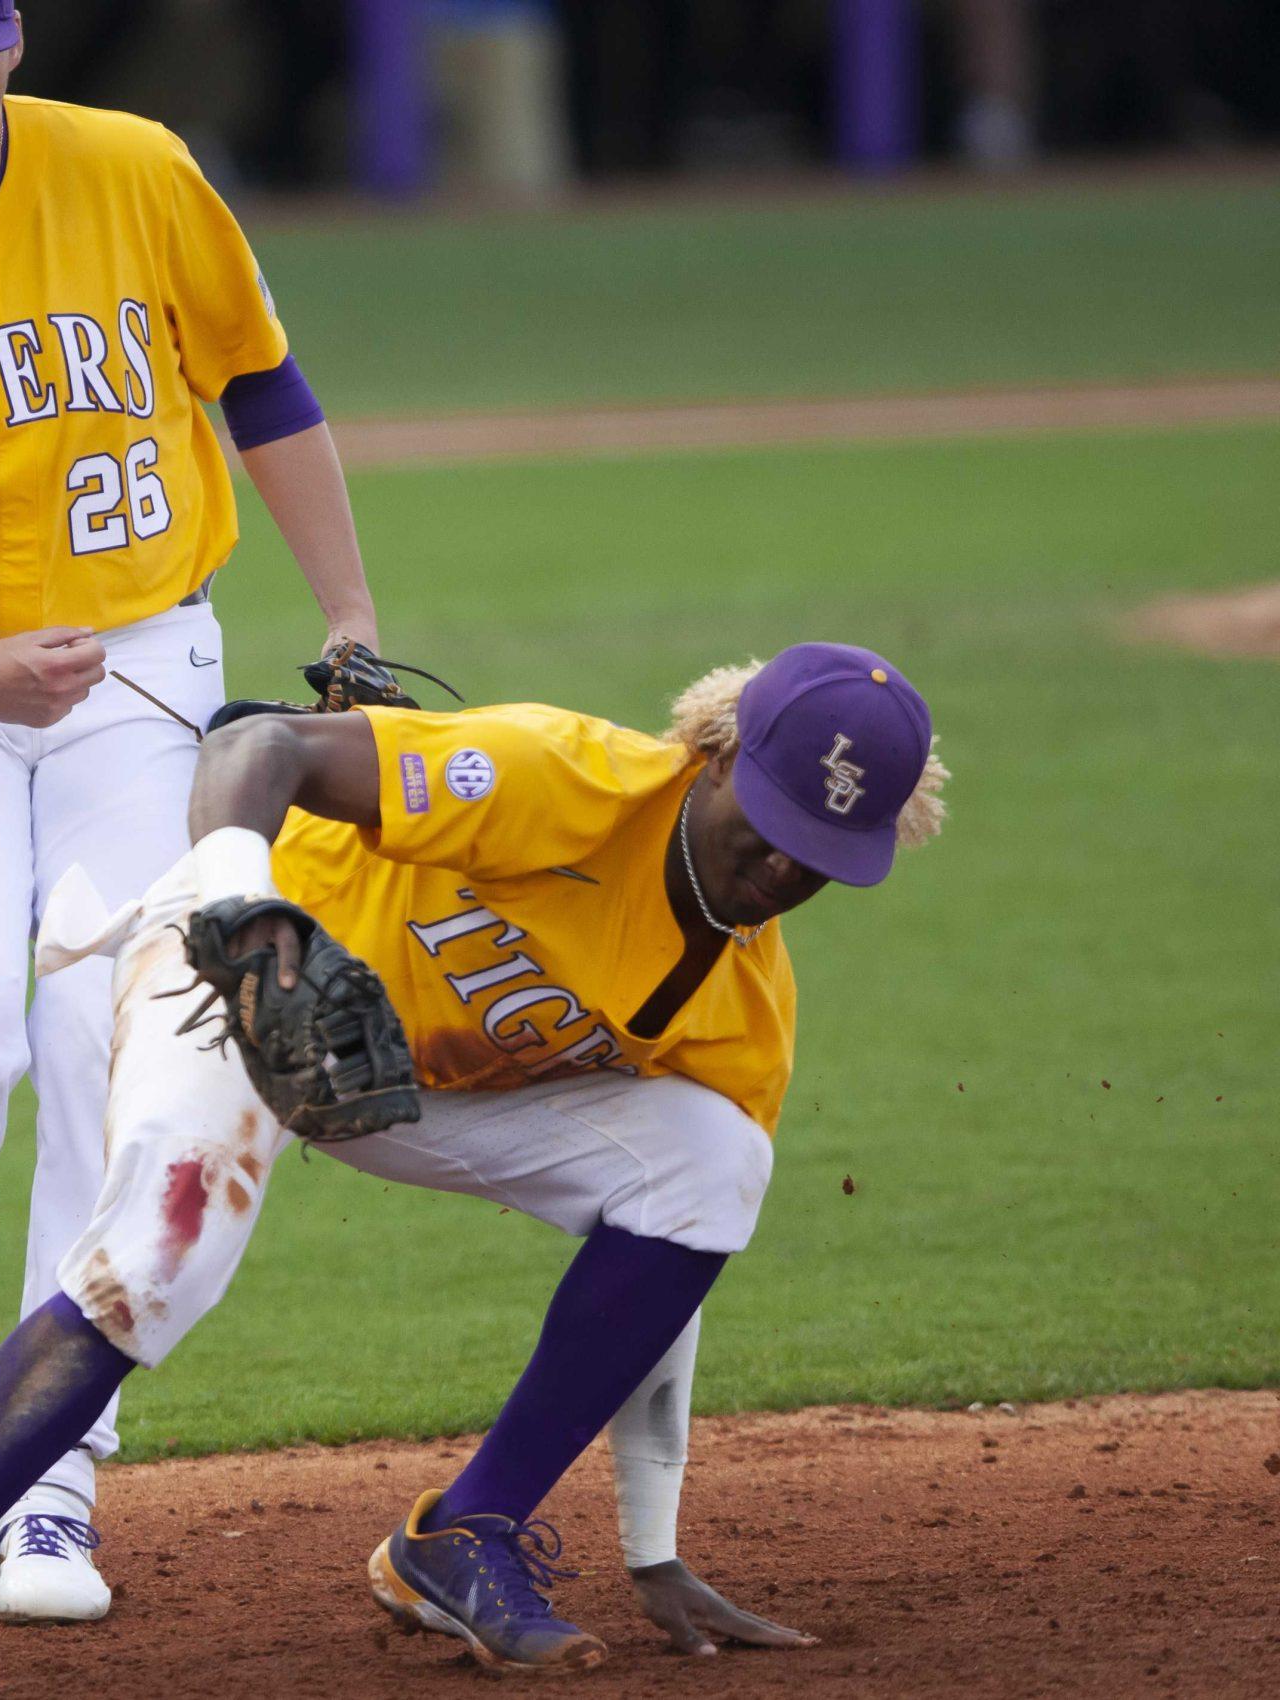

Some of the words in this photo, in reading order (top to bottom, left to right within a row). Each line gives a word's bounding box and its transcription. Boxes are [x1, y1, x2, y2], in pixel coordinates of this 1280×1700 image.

[67, 436, 173, 557] 26
[447, 748, 492, 799] SEC
[820, 732, 866, 815] LSU
